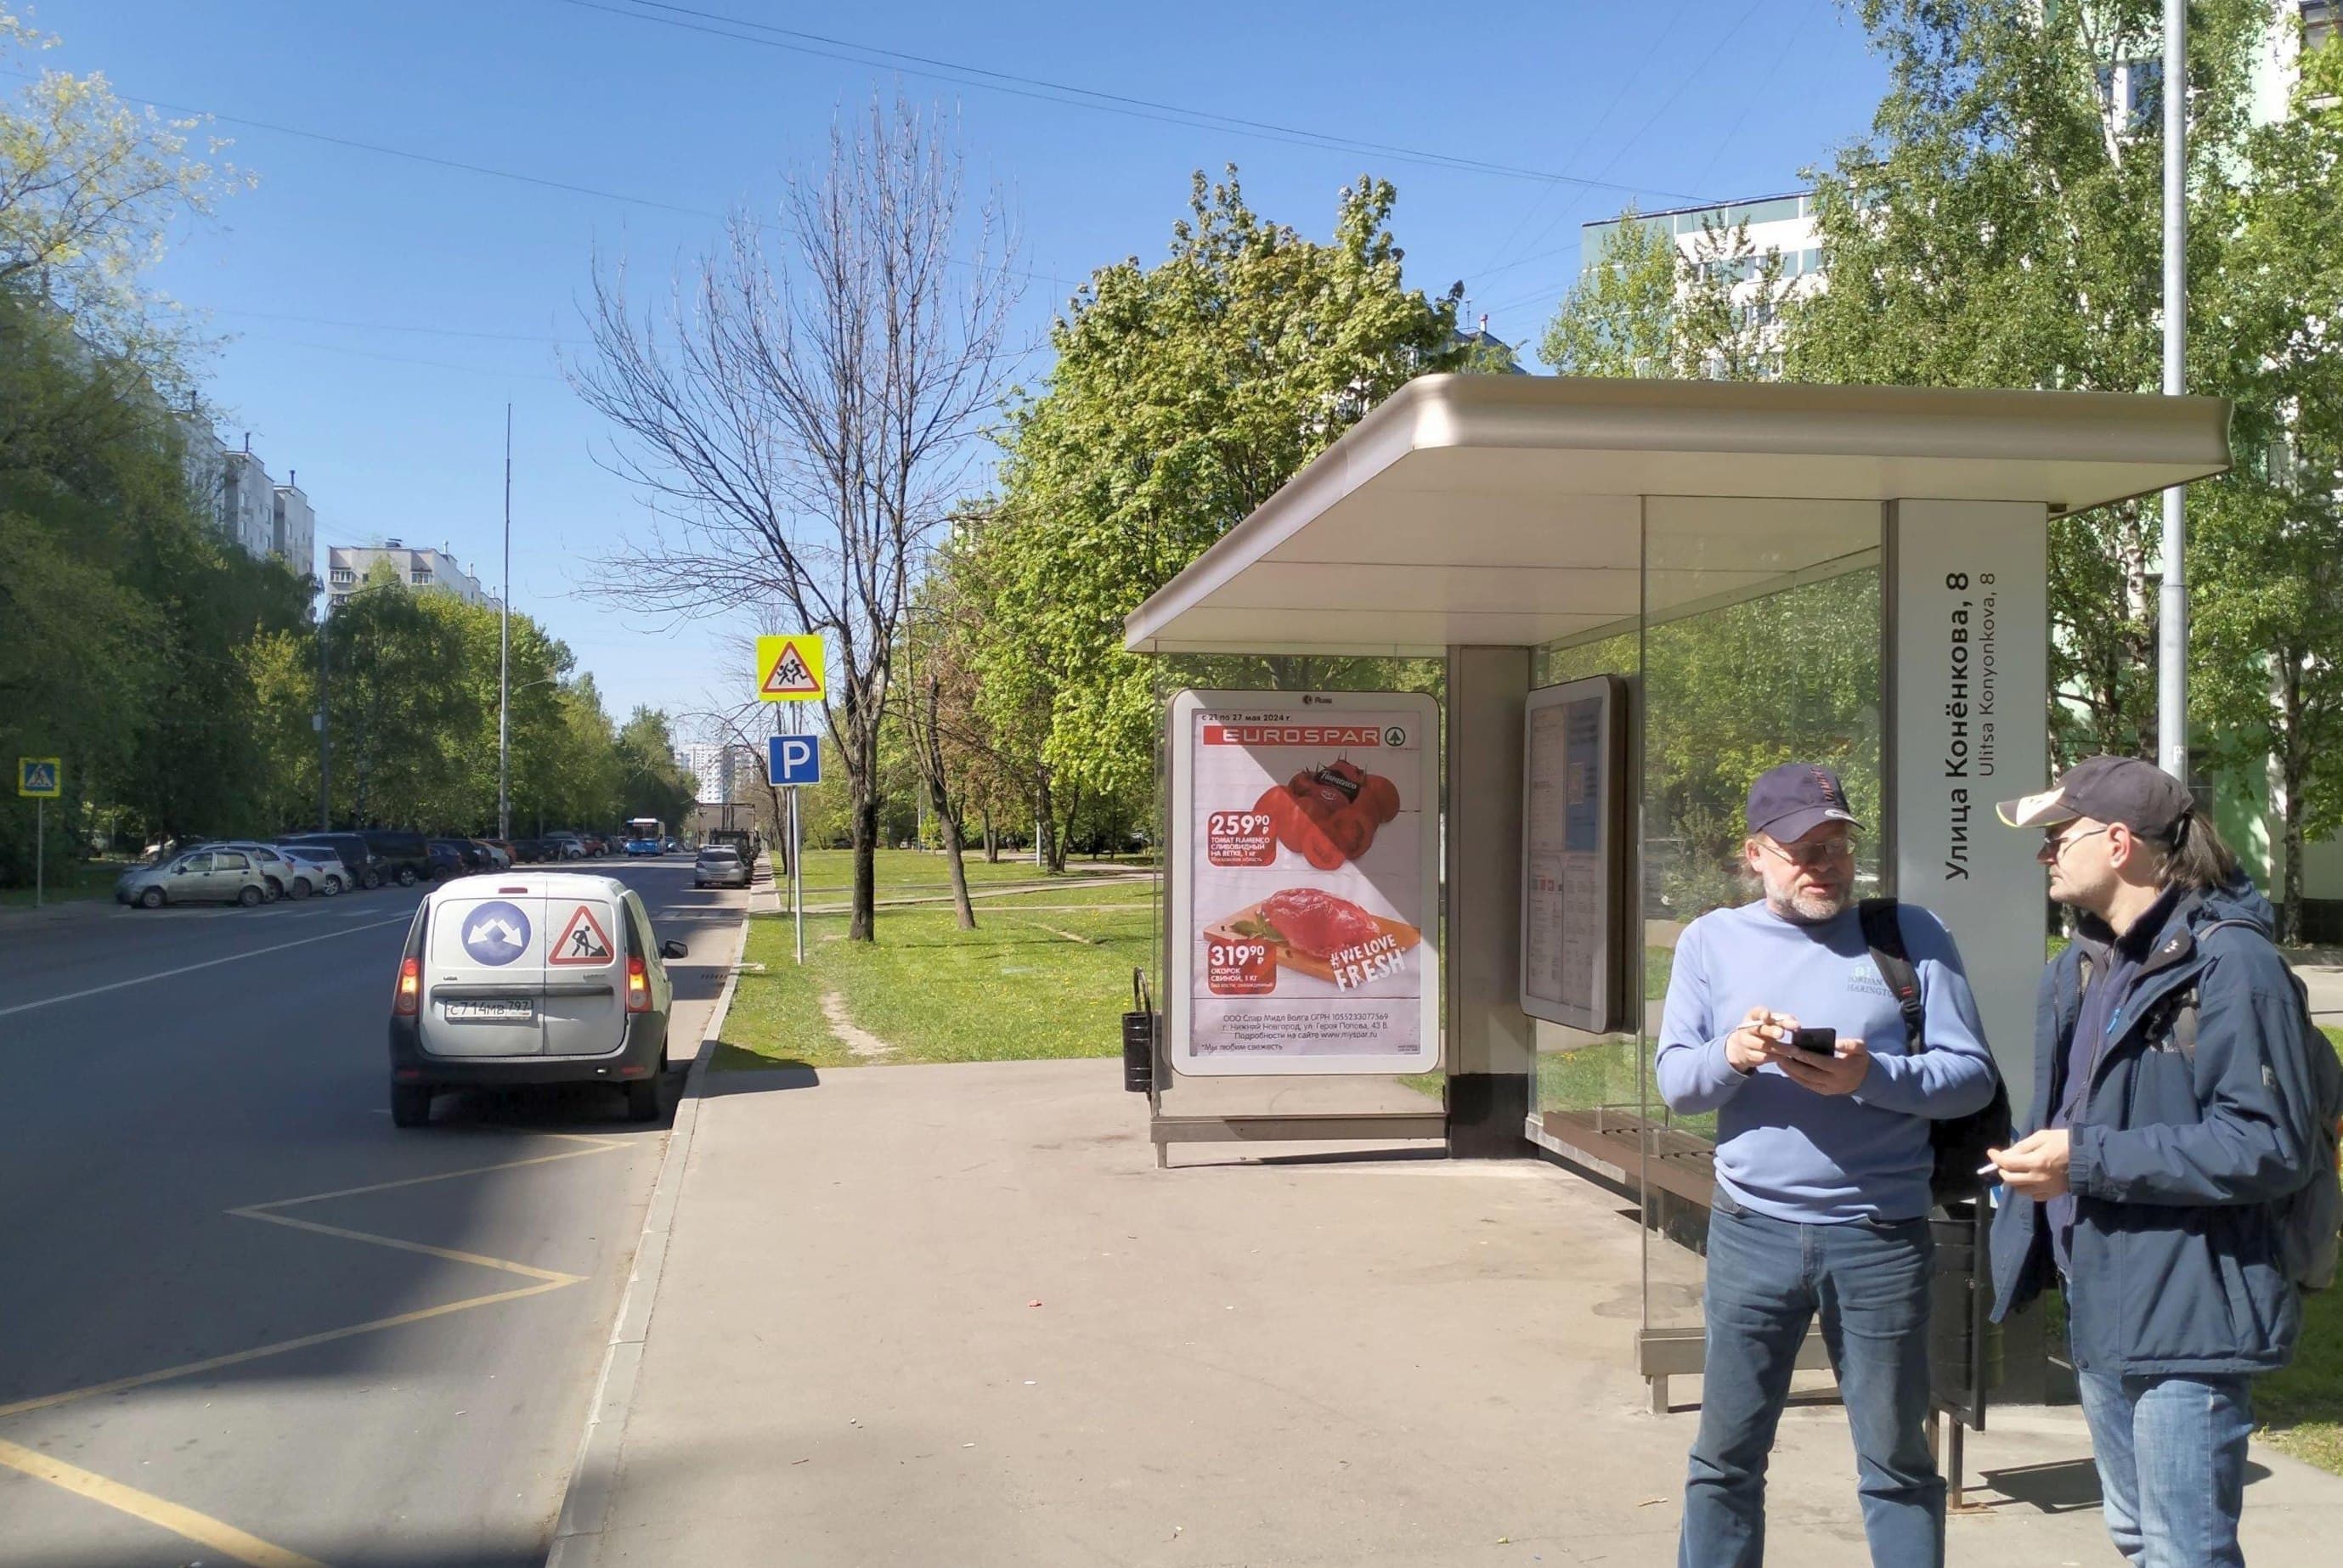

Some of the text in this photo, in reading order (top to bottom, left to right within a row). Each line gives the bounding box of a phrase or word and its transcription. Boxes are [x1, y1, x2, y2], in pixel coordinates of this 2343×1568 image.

[1978, 572, 1998, 776] Ulitsa Konyonkova, 8
[1263, 713, 1284, 722] 2024
[1945, 572, 1973, 881] Улица Конёнкова, 8
[1222, 728, 1378, 742] EUROSPAR
[782, 741, 810, 780] P
[1363, 933, 1397, 956] LOVE
[1242, 1014, 1262, 1023] Спар
[1287, 1013, 1309, 1022] Волга
[1316, 1022, 1338, 1031] Героя
[1234, 1031, 1285, 1041] Подробности
